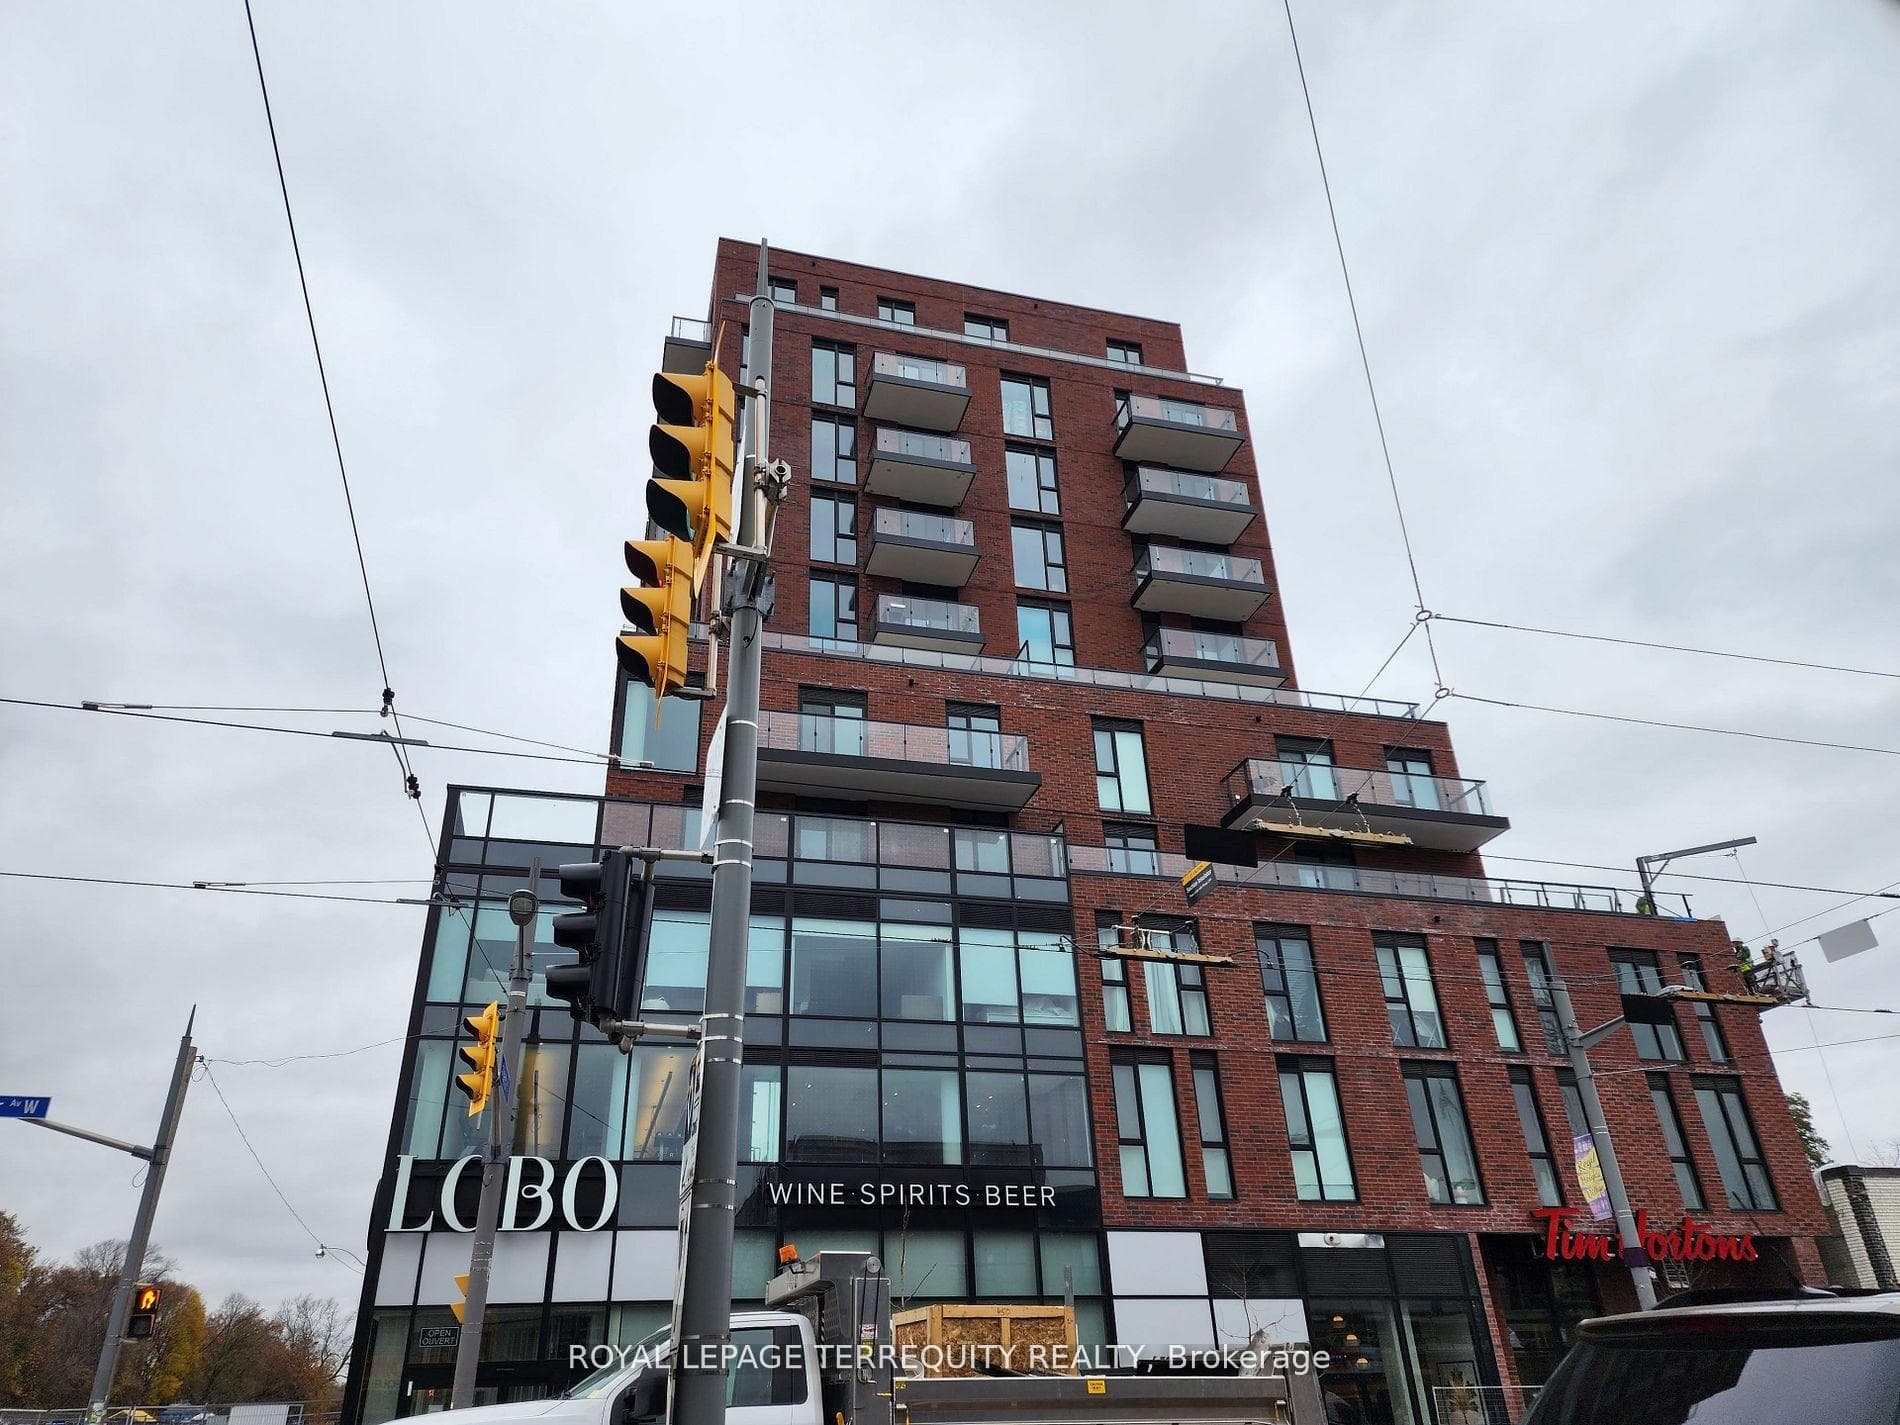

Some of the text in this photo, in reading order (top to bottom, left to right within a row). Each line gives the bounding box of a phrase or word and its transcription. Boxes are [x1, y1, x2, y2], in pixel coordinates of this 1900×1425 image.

[9, 1099, 22, 1107] Av
[23, 1100, 39, 1113] W
[384, 1154, 618, 1232] LCBO
[769, 1182, 1056, 1207] WINE SPIRITS BEER
[1530, 1207, 1612, 1262] Tim
[421, 1337, 456, 1346] OUVERT
[428, 1329, 450, 1338] OPEN
